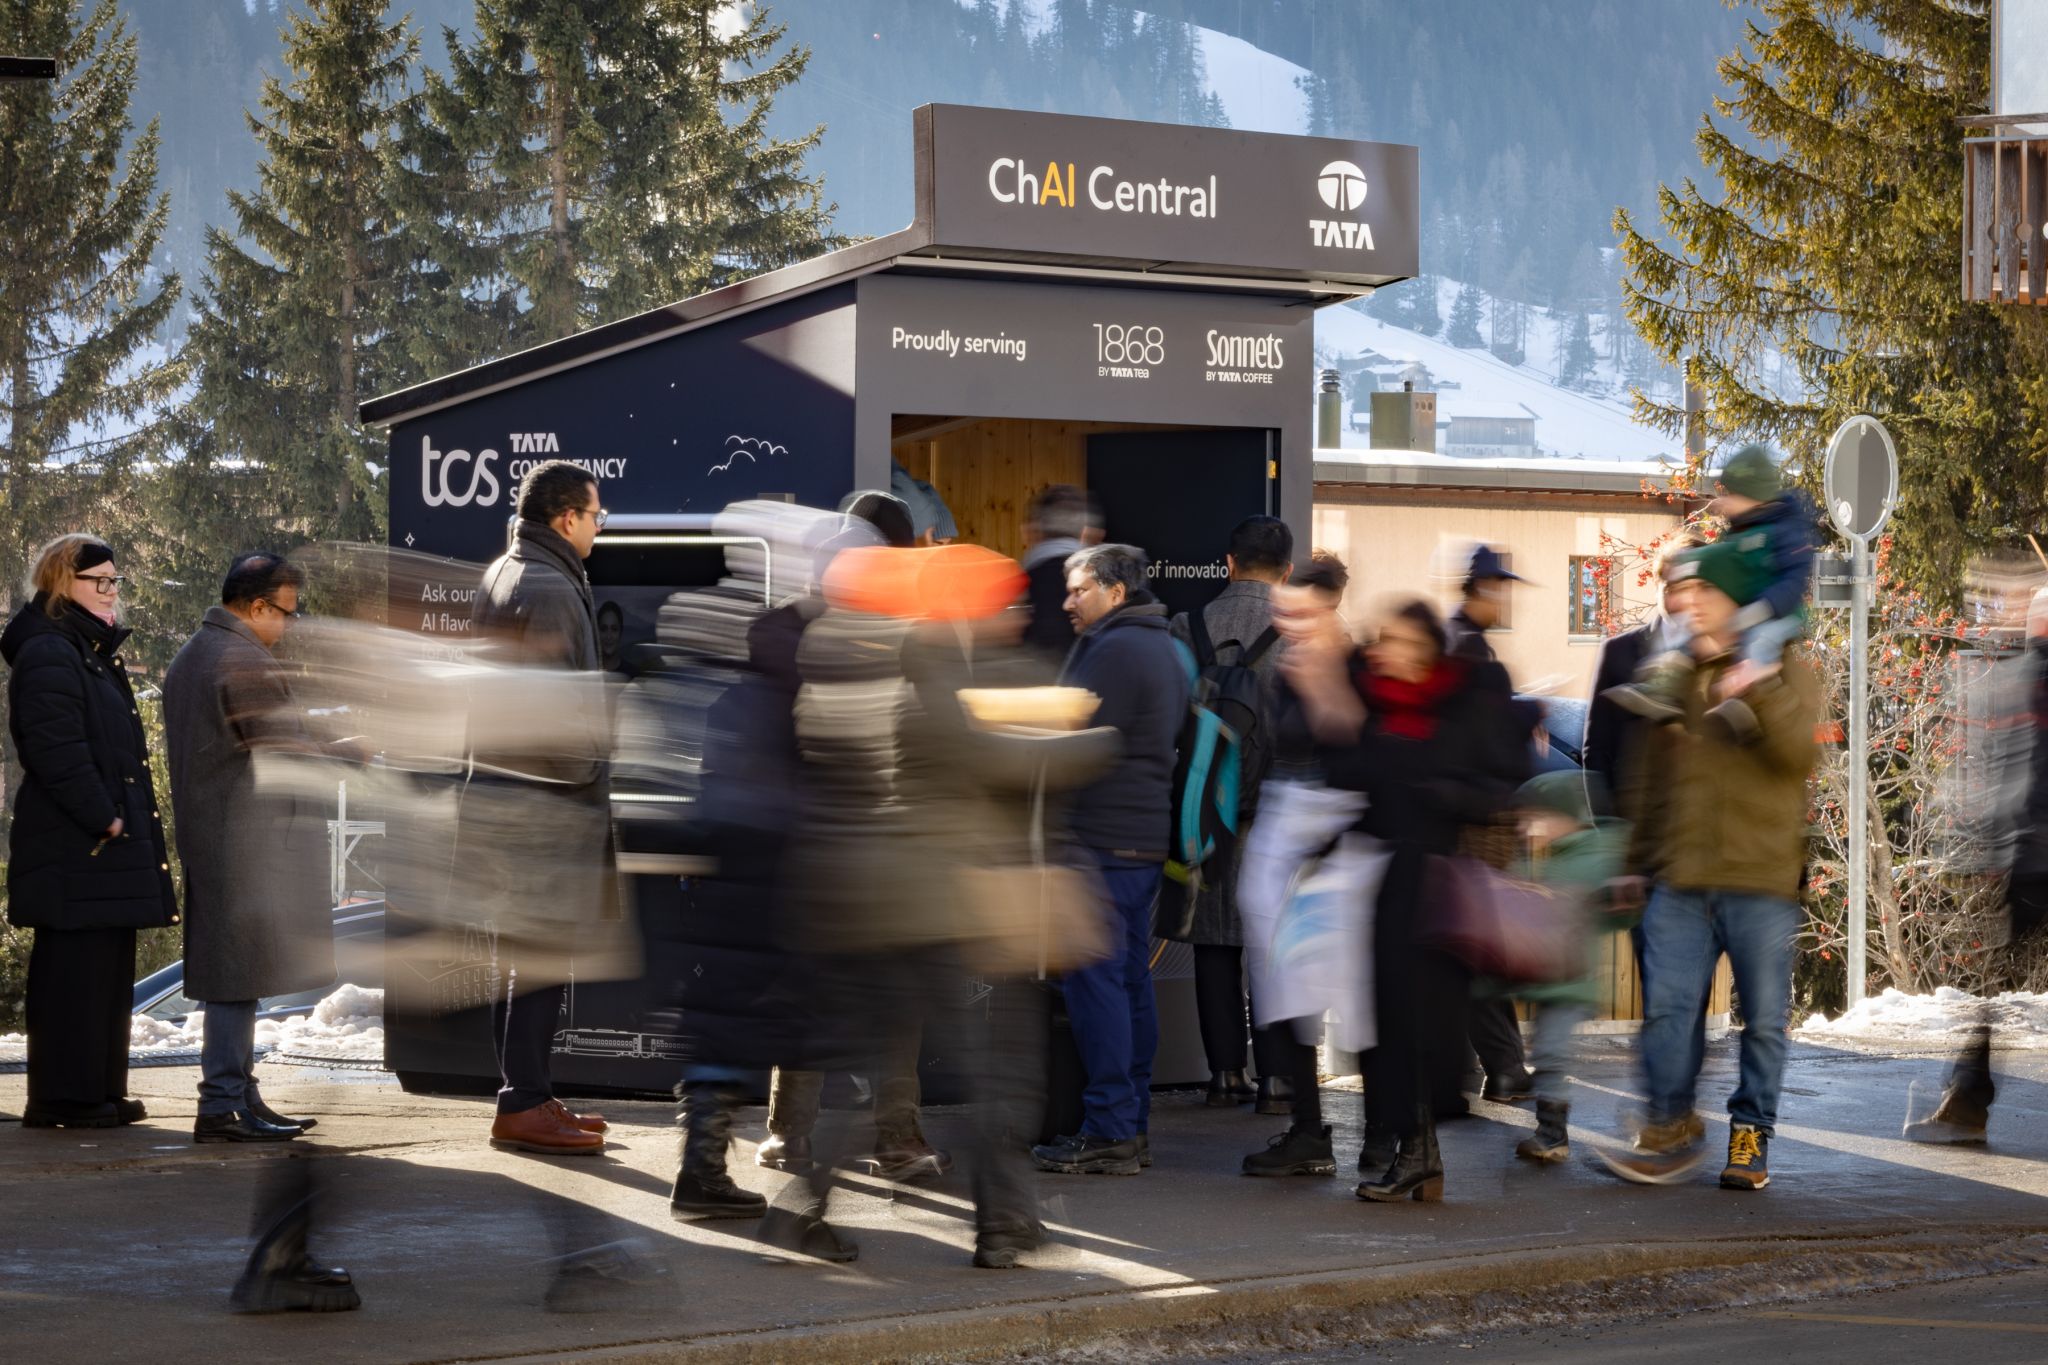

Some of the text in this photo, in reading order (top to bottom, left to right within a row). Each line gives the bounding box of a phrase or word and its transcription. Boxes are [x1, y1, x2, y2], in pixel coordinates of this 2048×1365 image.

[988, 157, 1217, 218] ChAI Central
[1309, 219, 1375, 251] TATA
[892, 326, 1027, 362] Proudly serving
[1093, 323, 1165, 365] 1868
[1206, 329, 1284, 370] Sonnets
[1098, 366, 1110, 377] BY
[1110, 367, 1134, 378] TATA
[1206, 370, 1273, 384] BY TATA COFFEE
[509, 432, 560, 454] TATA
[421, 434, 500, 508] tcs
[1146, 559, 1229, 579] of innovatio
[421, 583, 478, 603] Ask our
[421, 612, 437, 633] AI
